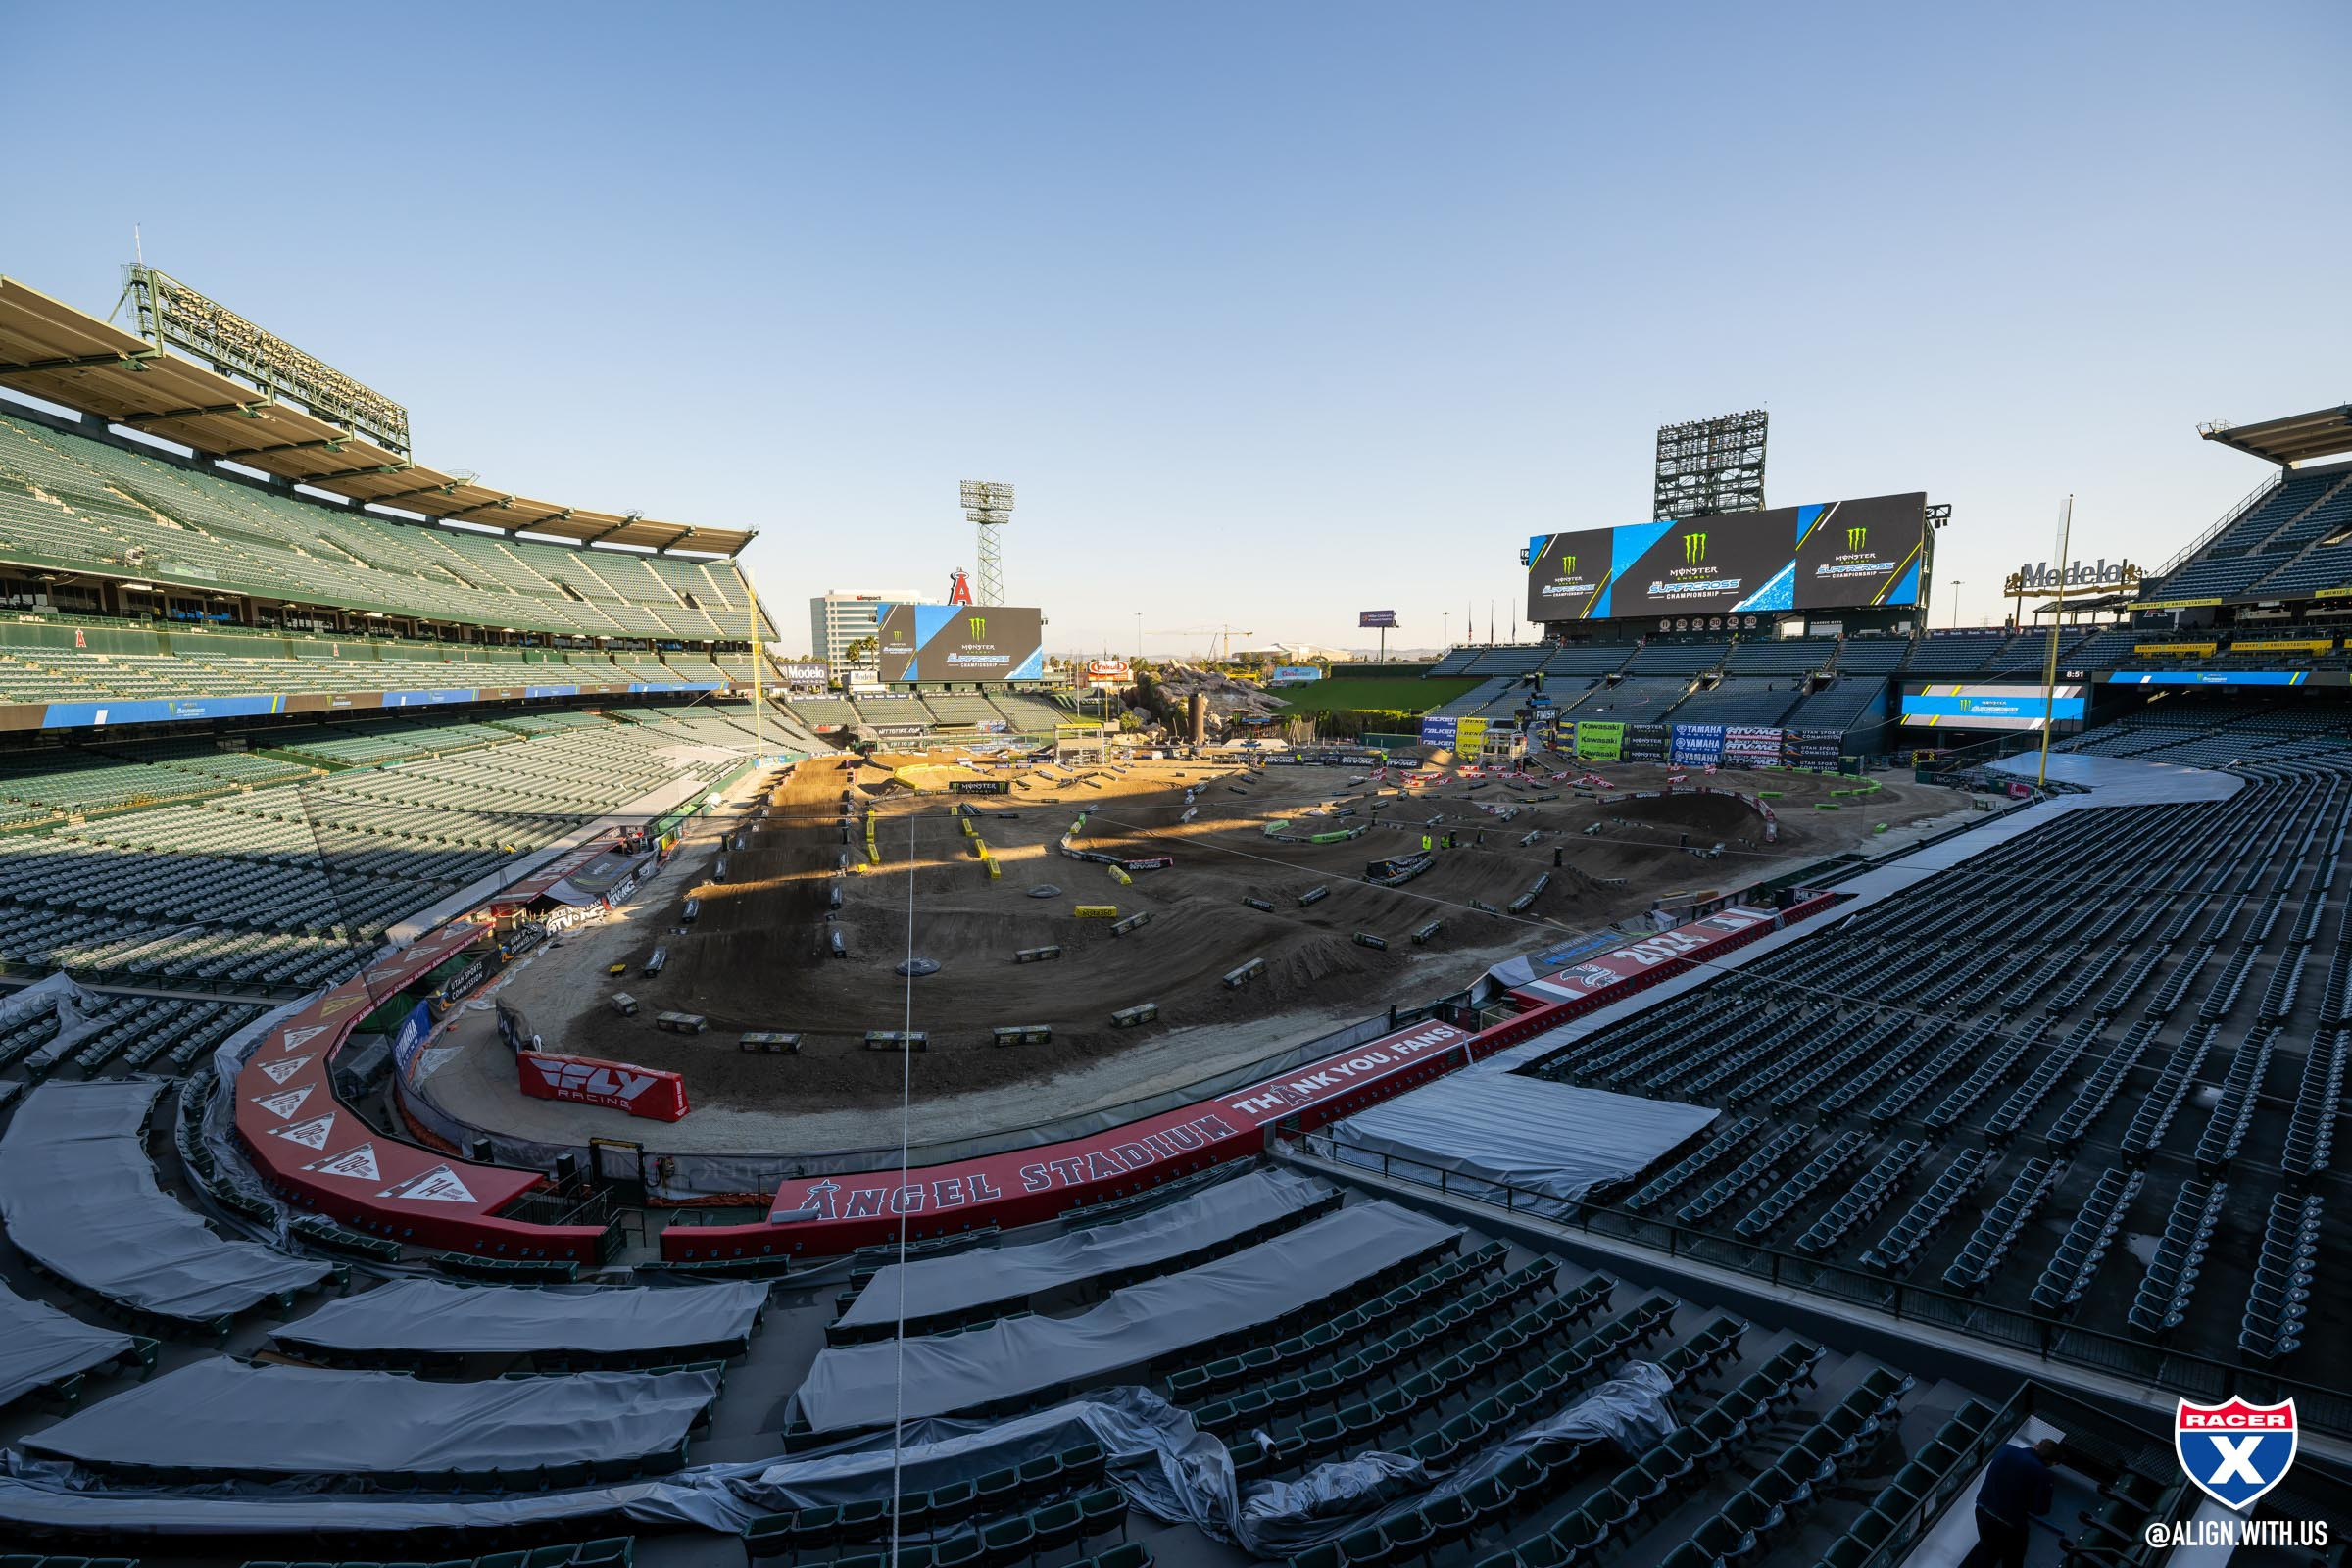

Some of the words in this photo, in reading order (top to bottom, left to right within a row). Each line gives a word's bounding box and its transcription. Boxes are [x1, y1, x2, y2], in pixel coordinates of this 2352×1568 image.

[1669, 566, 1719, 577] MONSTER
[1816, 562, 1896, 575] SUPERCROSS
[2022, 559, 2123, 588] Modelo
[1647, 578, 1742, 594] SUPERCROSS
[1666, 591, 1720, 600] CHAMPIONSHIP
[788, 666, 825, 679] Modelo
[1536, 710, 1555, 720] FINISH
[1687, 725, 1722, 734] YAMAHA
[1686, 739, 1721, 749] YAMAHA
[1684, 753, 1719, 762] YAMAHA
[1613, 932, 1711, 965] 2024
[451, 975, 464, 990] UTAH
[466, 961, 482, 979] SPORTS
[452, 972, 483, 1000] COMMISSION
[1231, 1070, 1342, 1114] THANK
[1331, 1052, 1401, 1078] YOU,
[1389, 1025, 1462, 1055] FANS!
[534, 1057, 659, 1101] FLY
[558, 1089, 630, 1108] RACING
[800, 1173, 1001, 1221] ANGEL
[1019, 1114, 1239, 1193] STADIUM
